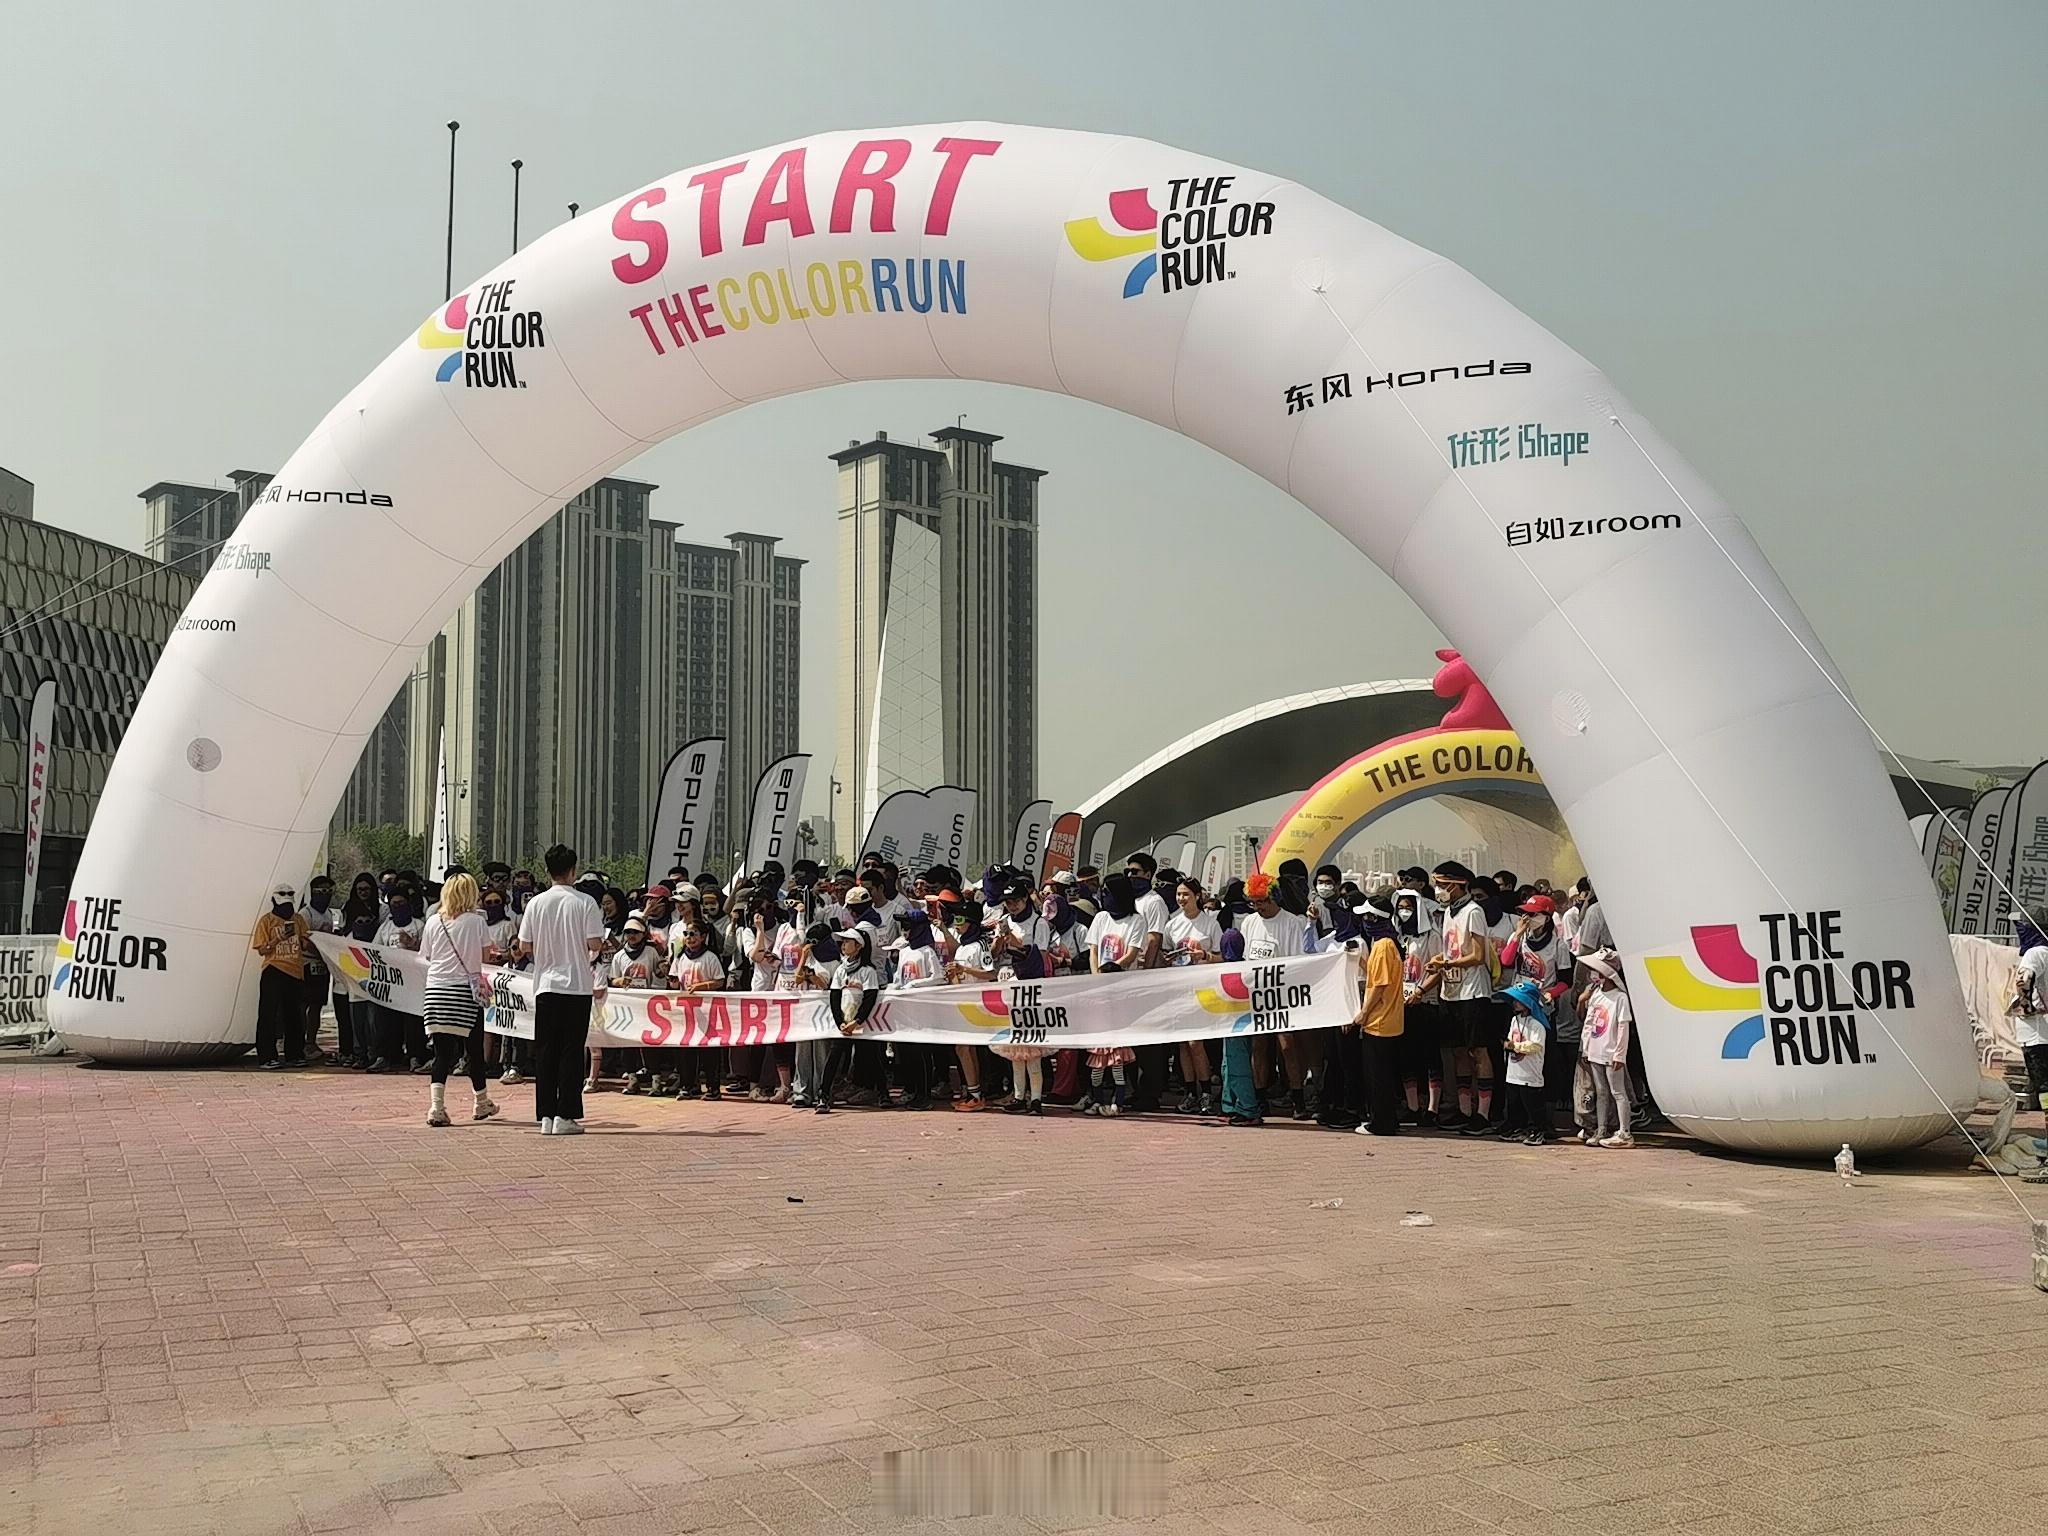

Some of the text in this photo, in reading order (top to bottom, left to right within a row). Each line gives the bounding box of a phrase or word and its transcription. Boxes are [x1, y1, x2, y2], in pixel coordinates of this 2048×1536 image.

[611, 137, 1004, 284] START
[1168, 176, 1236, 211] THE
[1161, 202, 1276, 250] COLOR
[1162, 241, 1226, 294] RUN
[475, 279, 516, 315] THE
[466, 311, 545, 350] COLOR
[465, 351, 518, 388] RUN
[1284, 359, 1532, 415] 东风 Honda
[1447, 424, 1589, 469] 优形 iShape
[286, 489, 394, 508] Honda
[1363, 745, 1534, 793] THE COLOR
[673, 753, 706, 867] Honda
[767, 768, 794, 858] onda
[947, 813, 965, 868] room
[1023, 822, 1041, 873] room
[84, 896, 122, 931] THE
[74, 931, 167, 971] COLOR
[1759, 910, 1844, 961] THE
[0, 949, 35, 974] THE
[362, 947, 387, 966] THE
[371, 963, 404, 986] COLOR
[0, 974, 51, 1000] COLO
[68, 965, 117, 1002] RUN
[493, 972, 516, 991] THE
[1252, 964, 1286, 989] THE
[1765, 960, 1915, 1014] COLOR
[494, 989, 527, 1012] COLOR
[1010, 985, 1042, 1007] THE
[1251, 984, 1312, 1012] COLOR
[641, 994, 801, 1047] START
[1010, 1006, 1069, 1028] COLOR
[1254, 1012, 1290, 1032] RUN
[1770, 1014, 1861, 1066] RUN
